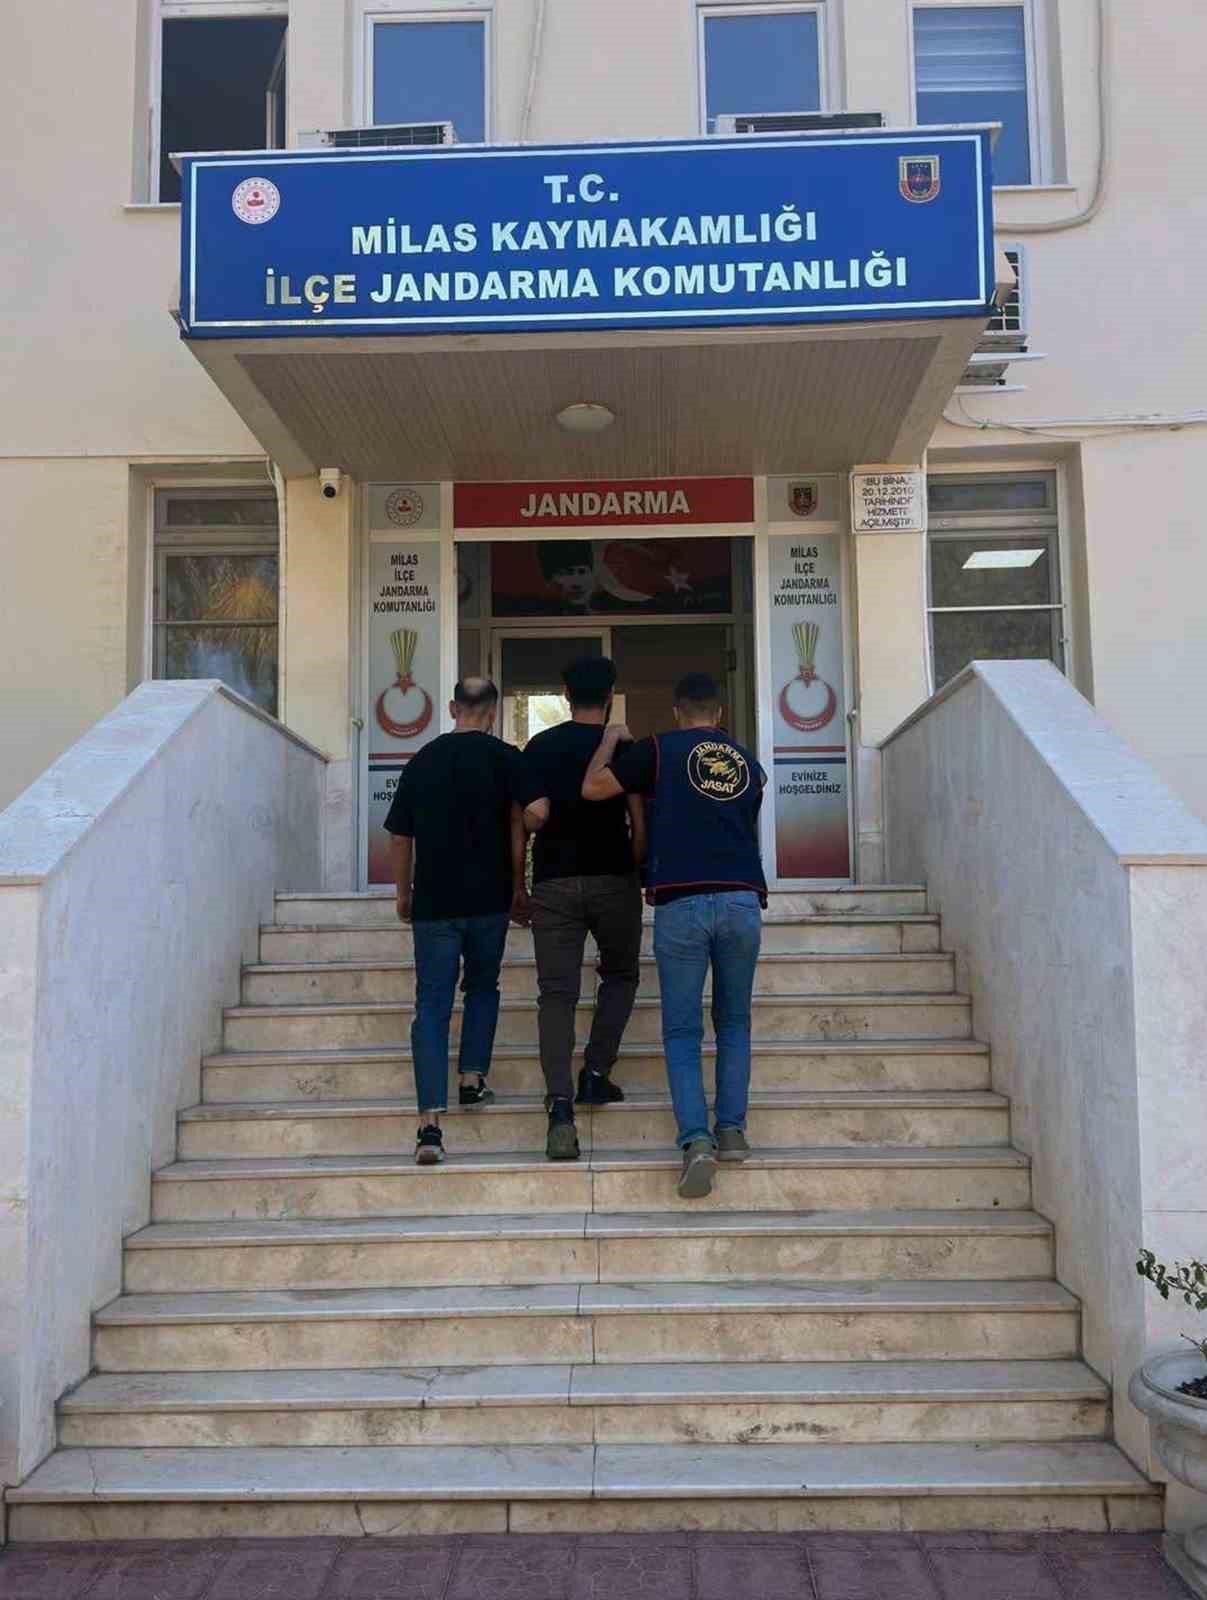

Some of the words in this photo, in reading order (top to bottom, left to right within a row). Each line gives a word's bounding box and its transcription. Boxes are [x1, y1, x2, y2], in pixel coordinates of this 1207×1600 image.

[543, 173, 619, 204] T.C.
[352, 217, 478, 255] MİLAS
[492, 204, 817, 252] KAYMAKAMLIĞI
[265, 268, 357, 313] İLÇE
[370, 267, 599, 304] JANDARMA
[614, 250, 907, 298] KOMUTANLIĞI
[520, 489, 690, 518] JANDARMA
[790, 545, 818, 558] MİLAS
[390, 553, 418, 566] MİLAS
[395, 567, 415, 583] İLÇE
[795, 560, 815, 576] İLÇE
[780, 577, 830, 590] JANDARMA
[380, 585, 429, 597] JANDARMA
[373, 599, 436, 613] KOMUTANLIĞI
[791, 769, 829, 782] EVİNİZE
[700, 779, 737, 794] JASAT
[779, 782, 841, 796] HOŞGELDİNİZ
